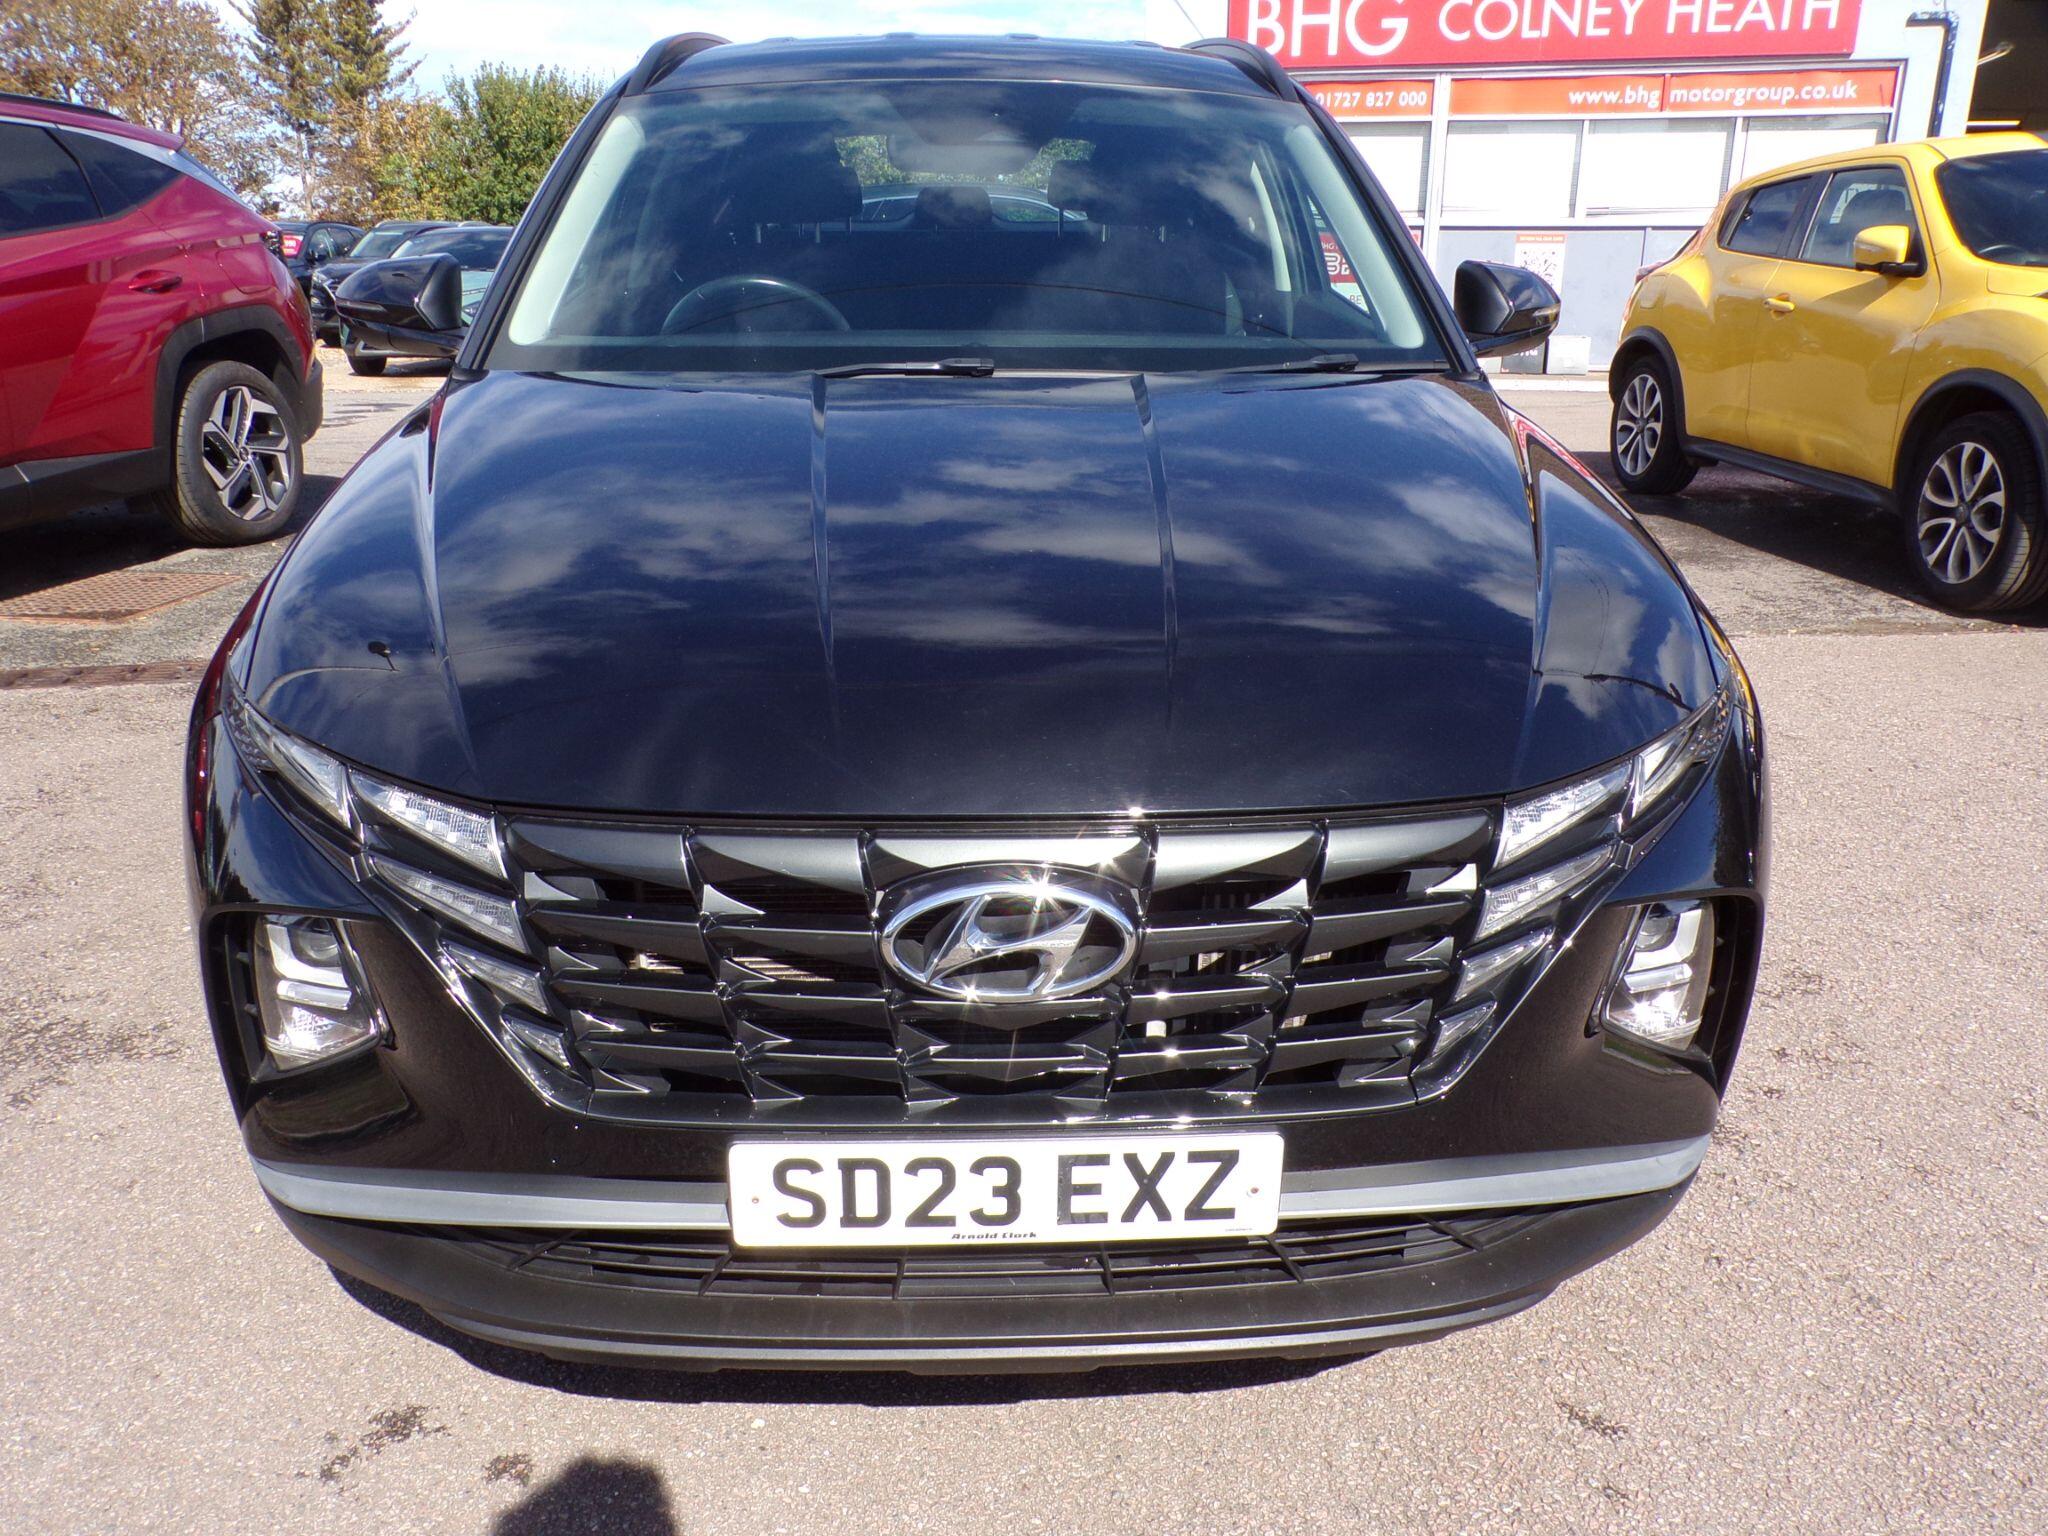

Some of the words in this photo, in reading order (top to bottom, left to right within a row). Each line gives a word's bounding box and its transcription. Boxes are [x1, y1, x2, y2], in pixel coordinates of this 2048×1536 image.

[1247, 0, 1409, 57] BHG
[1438, 0, 1642, 41] COLNEY
[1665, 0, 1841, 34] HEATH
[1315, 91, 1361, 108] 01727
[1365, 91, 1394, 108] 827
[1398, 90, 1427, 106] 000
[773, 1156, 1021, 1228] SD23
[1057, 1149, 1240, 1225] EXZ
[951, 1232, 998, 1240] Arnold
[1001, 1231, 1037, 1239] Clark
